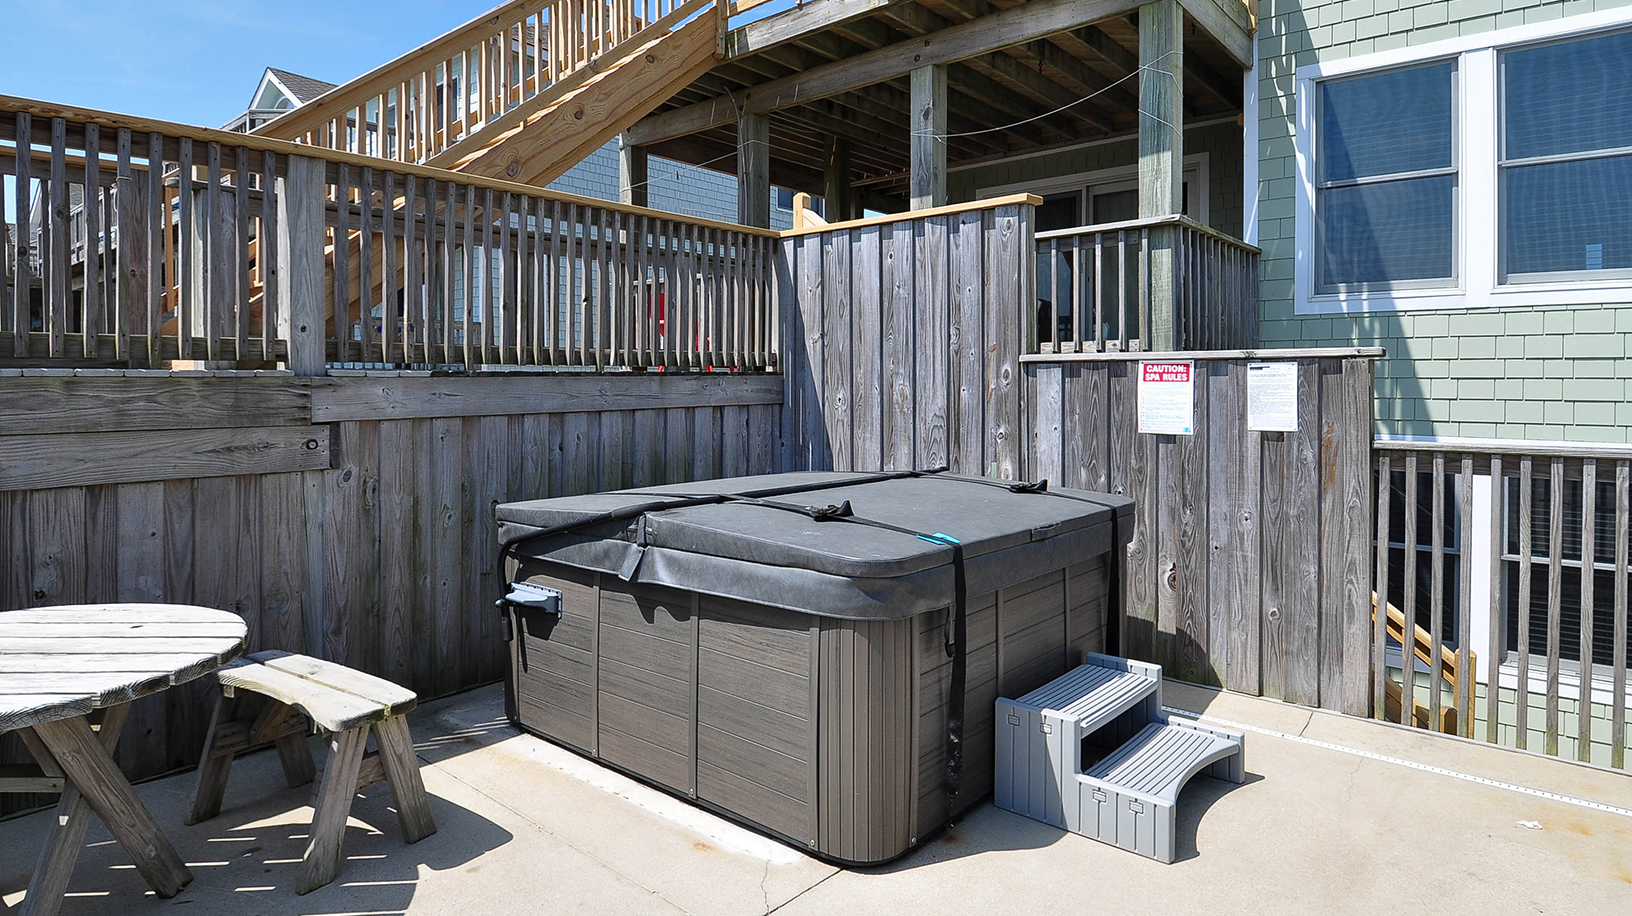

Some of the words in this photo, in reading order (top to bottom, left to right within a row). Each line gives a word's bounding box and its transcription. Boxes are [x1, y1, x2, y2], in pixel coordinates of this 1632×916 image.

[1146, 365, 1187, 373] CAUTION:
[1145, 373, 1160, 381] SPA
[1163, 373, 1187, 381] RULES
